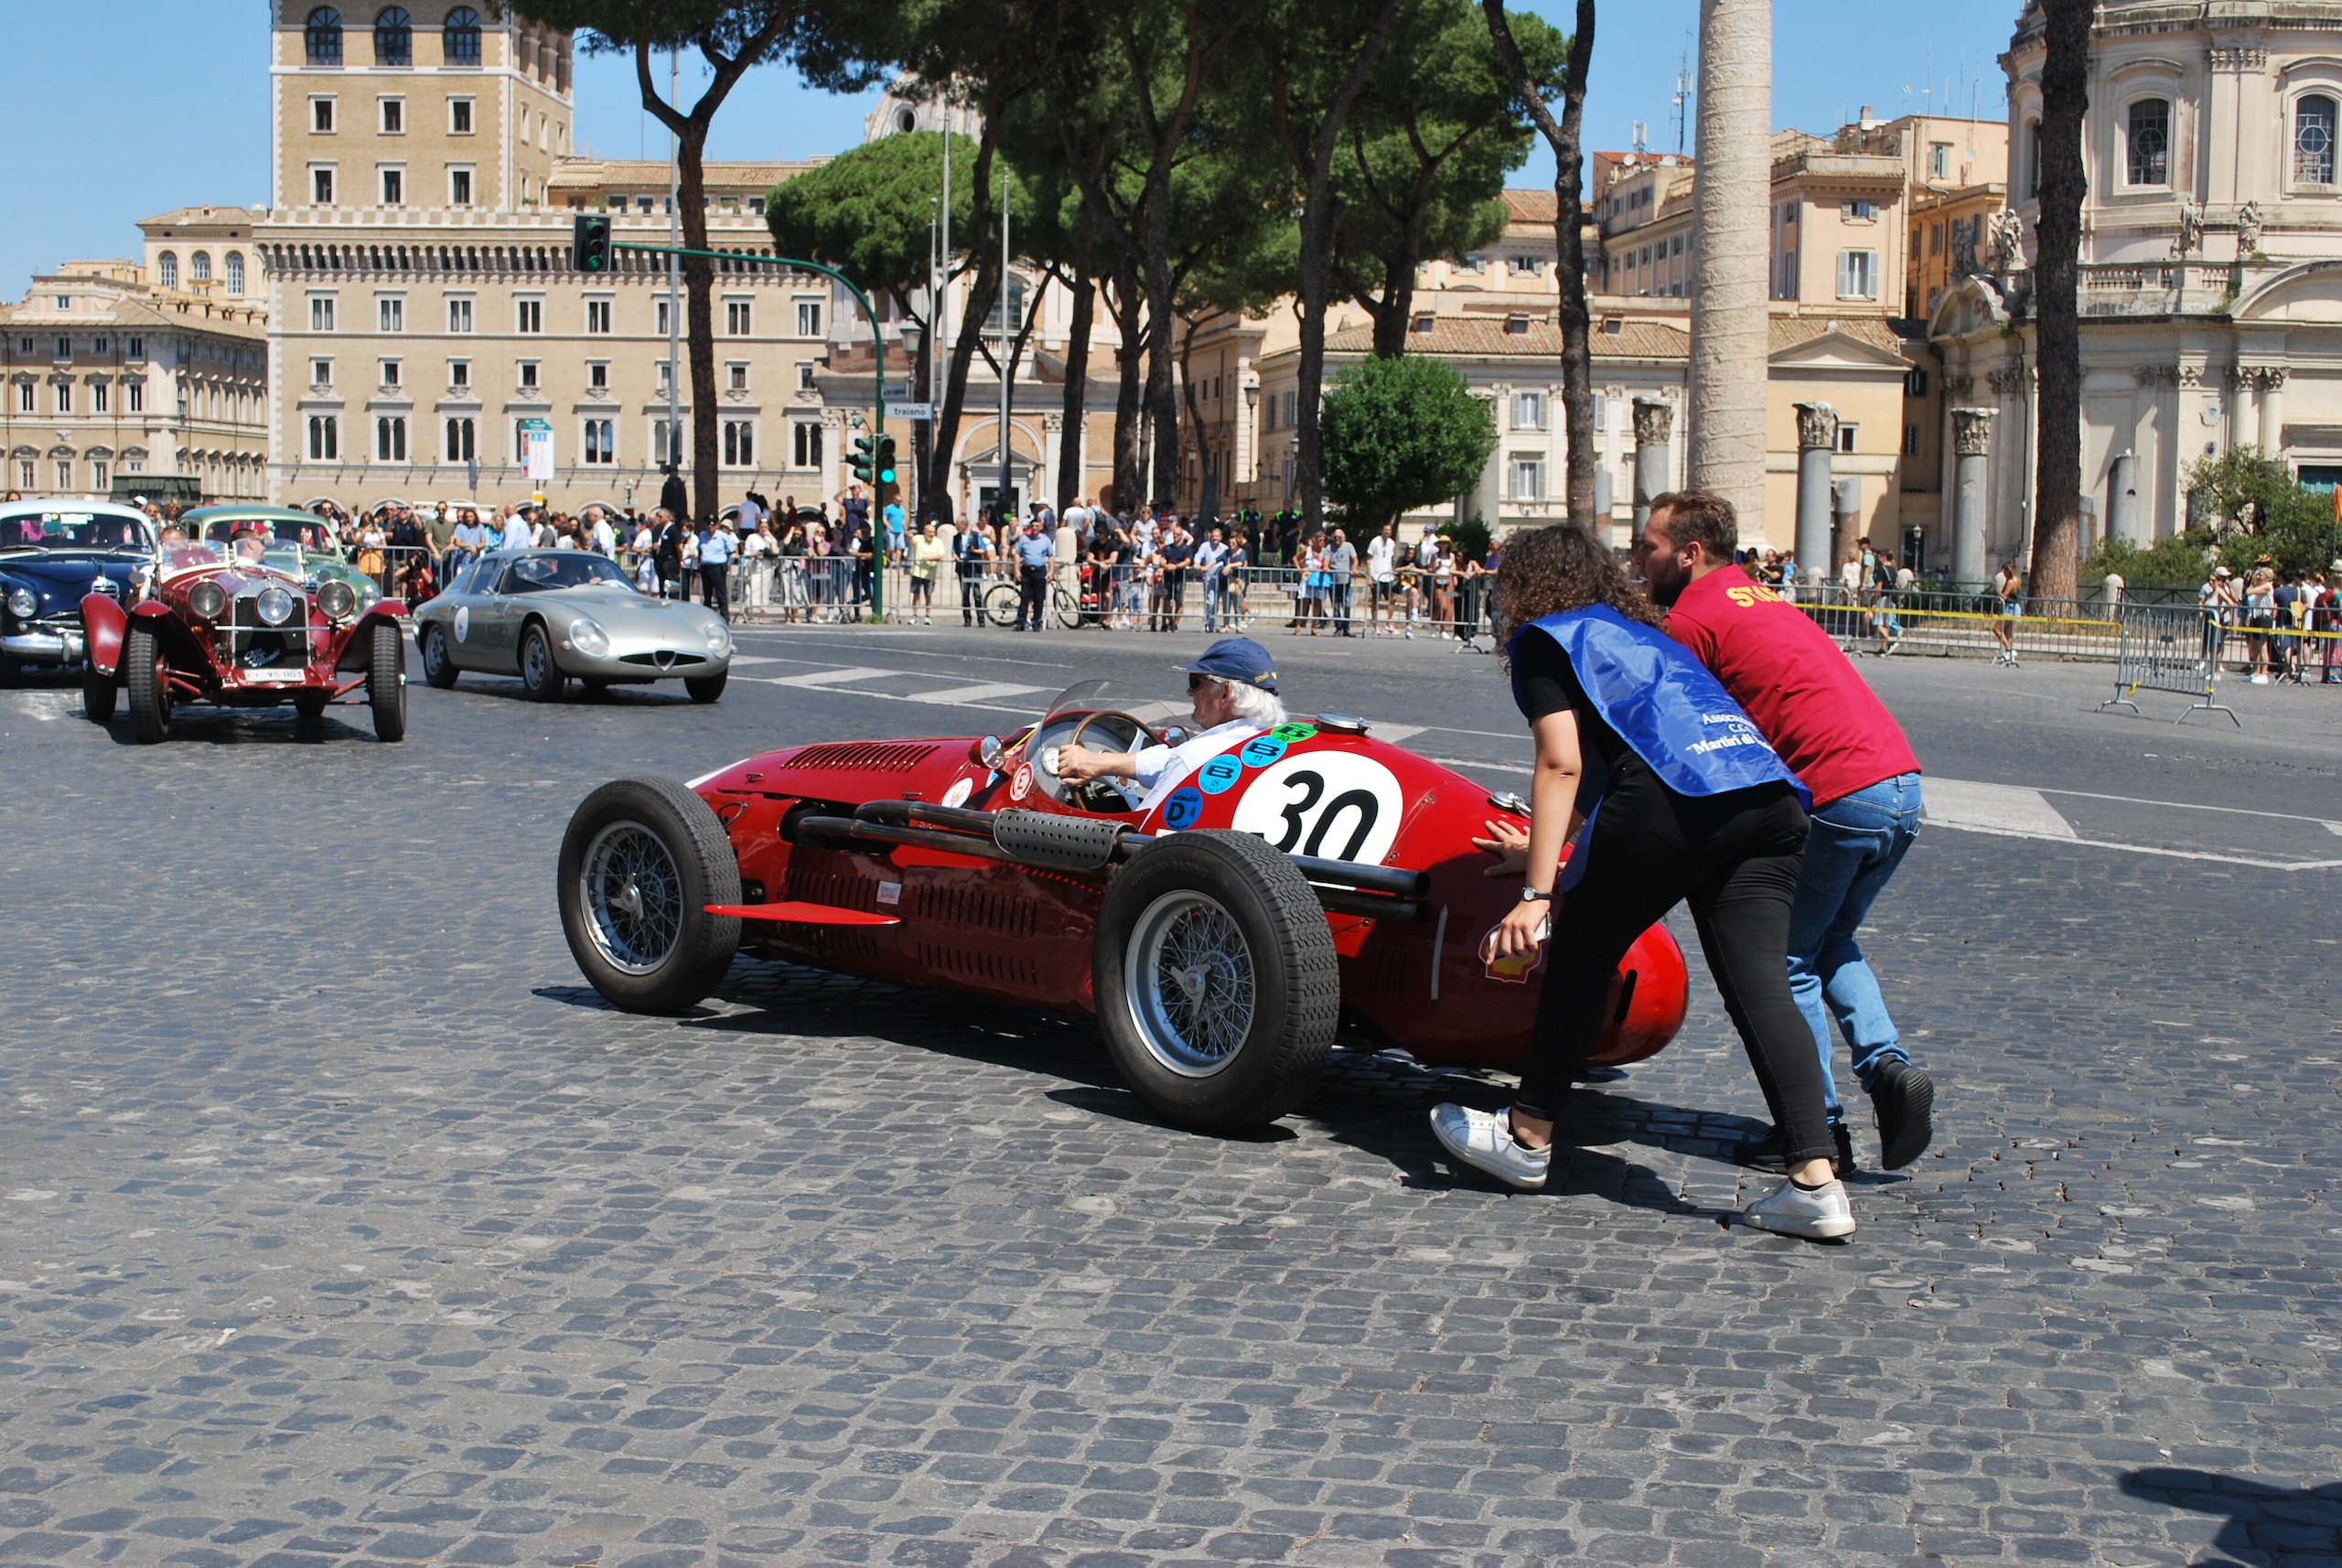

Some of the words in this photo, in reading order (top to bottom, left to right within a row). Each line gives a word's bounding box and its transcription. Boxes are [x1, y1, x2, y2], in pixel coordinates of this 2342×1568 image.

[895, 407, 926, 416] traiano
[1725, 585, 1784, 607] STAF
[1741, 733, 1756, 745] di
[1246, 742, 1280, 757] B
[1205, 765, 1234, 779] B
[1017, 772, 1026, 789] E
[1166, 801, 1185, 822] D
[1189, 806, 1197, 819] 4
[1251, 770, 1380, 862] 30
